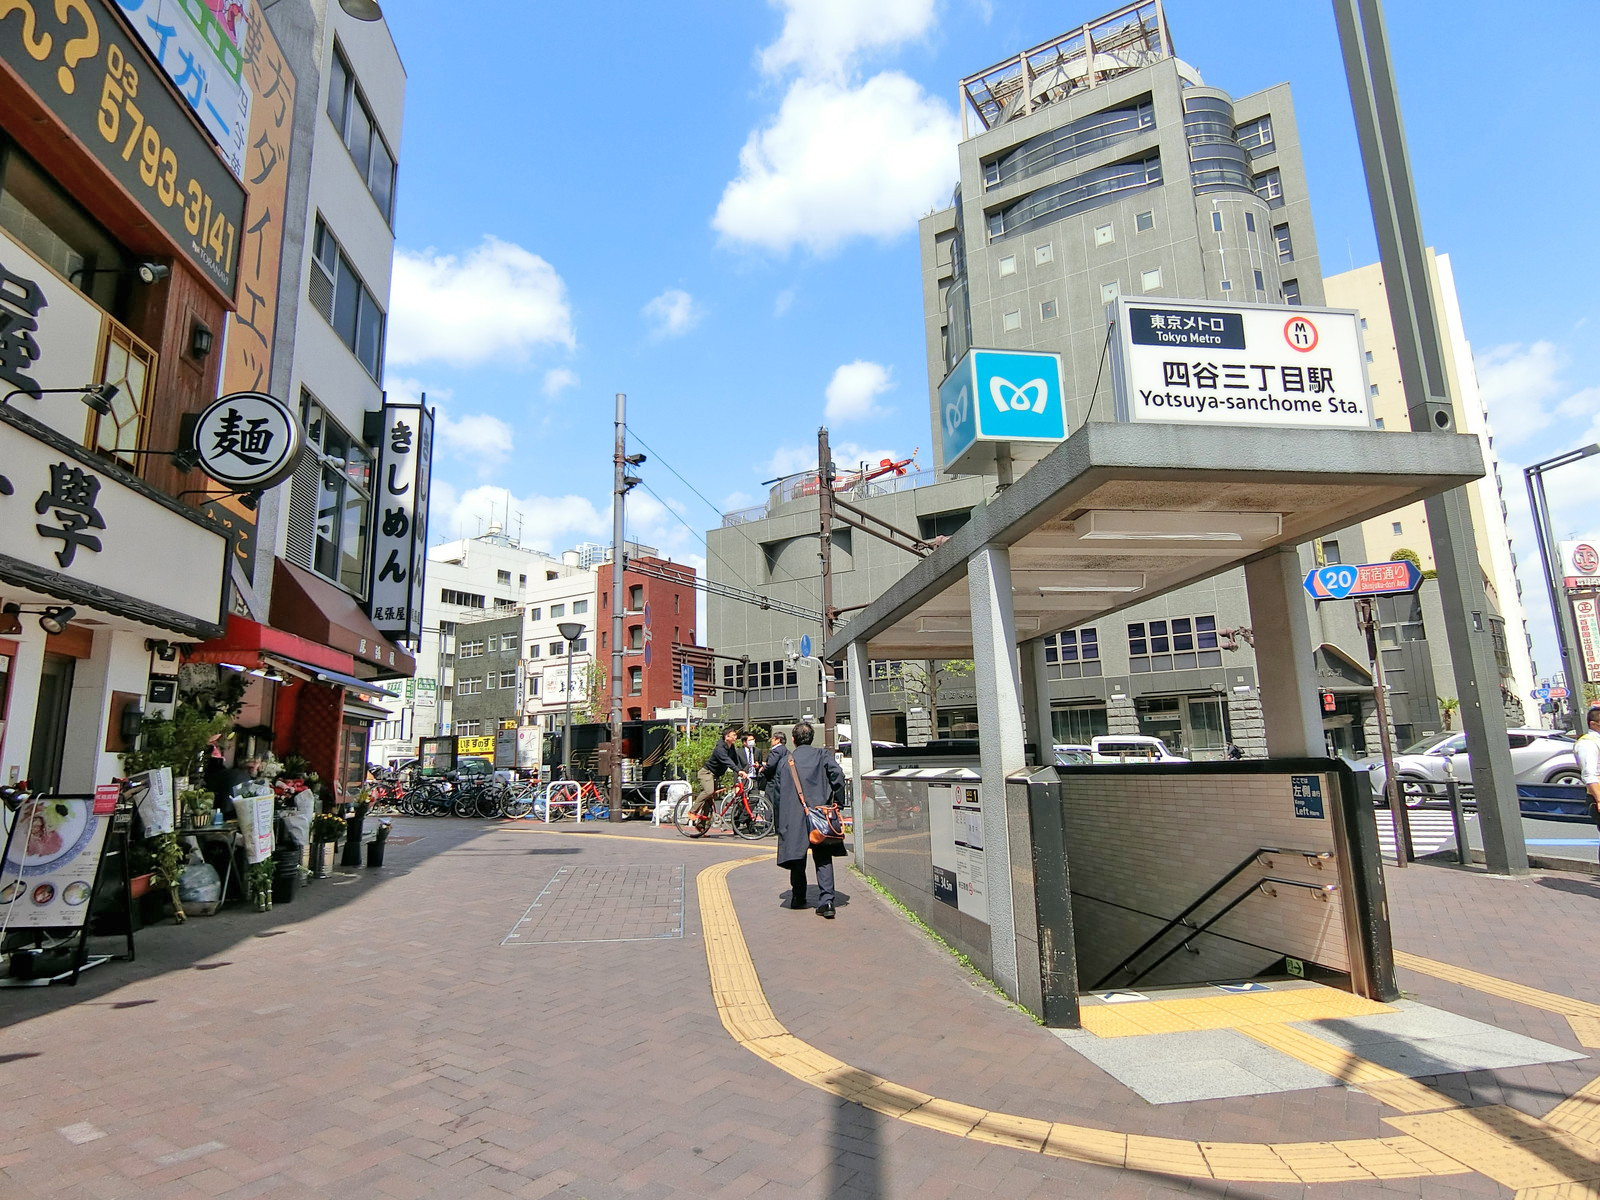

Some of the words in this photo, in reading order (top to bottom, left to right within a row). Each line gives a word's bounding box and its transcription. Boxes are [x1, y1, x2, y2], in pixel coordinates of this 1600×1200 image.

[107, 43, 139, 98] 03
[117, 0, 230, 137] イガー
[97, 73, 235, 274] 5793-3141
[1149, 313, 1225, 332] 東京メトロ
[1294, 322, 1306, 333] M
[1155, 331, 1187, 346] Tokyo
[1189, 332, 1222, 345] Metro
[1294, 333, 1309, 345] 11
[1162, 361, 1335, 394] 四谷三丁目駅
[1139, 389, 1322, 413] Yotsuya-sanchome
[1328, 396, 1364, 415] Sta.
[378, 420, 414, 584] きしめん
[1325, 570, 1353, 590] 20
[1359, 565, 1406, 582] 新宿通り
[373, 606, 406, 621] 尾張屋
[1296, 806, 1310, 816] Left
